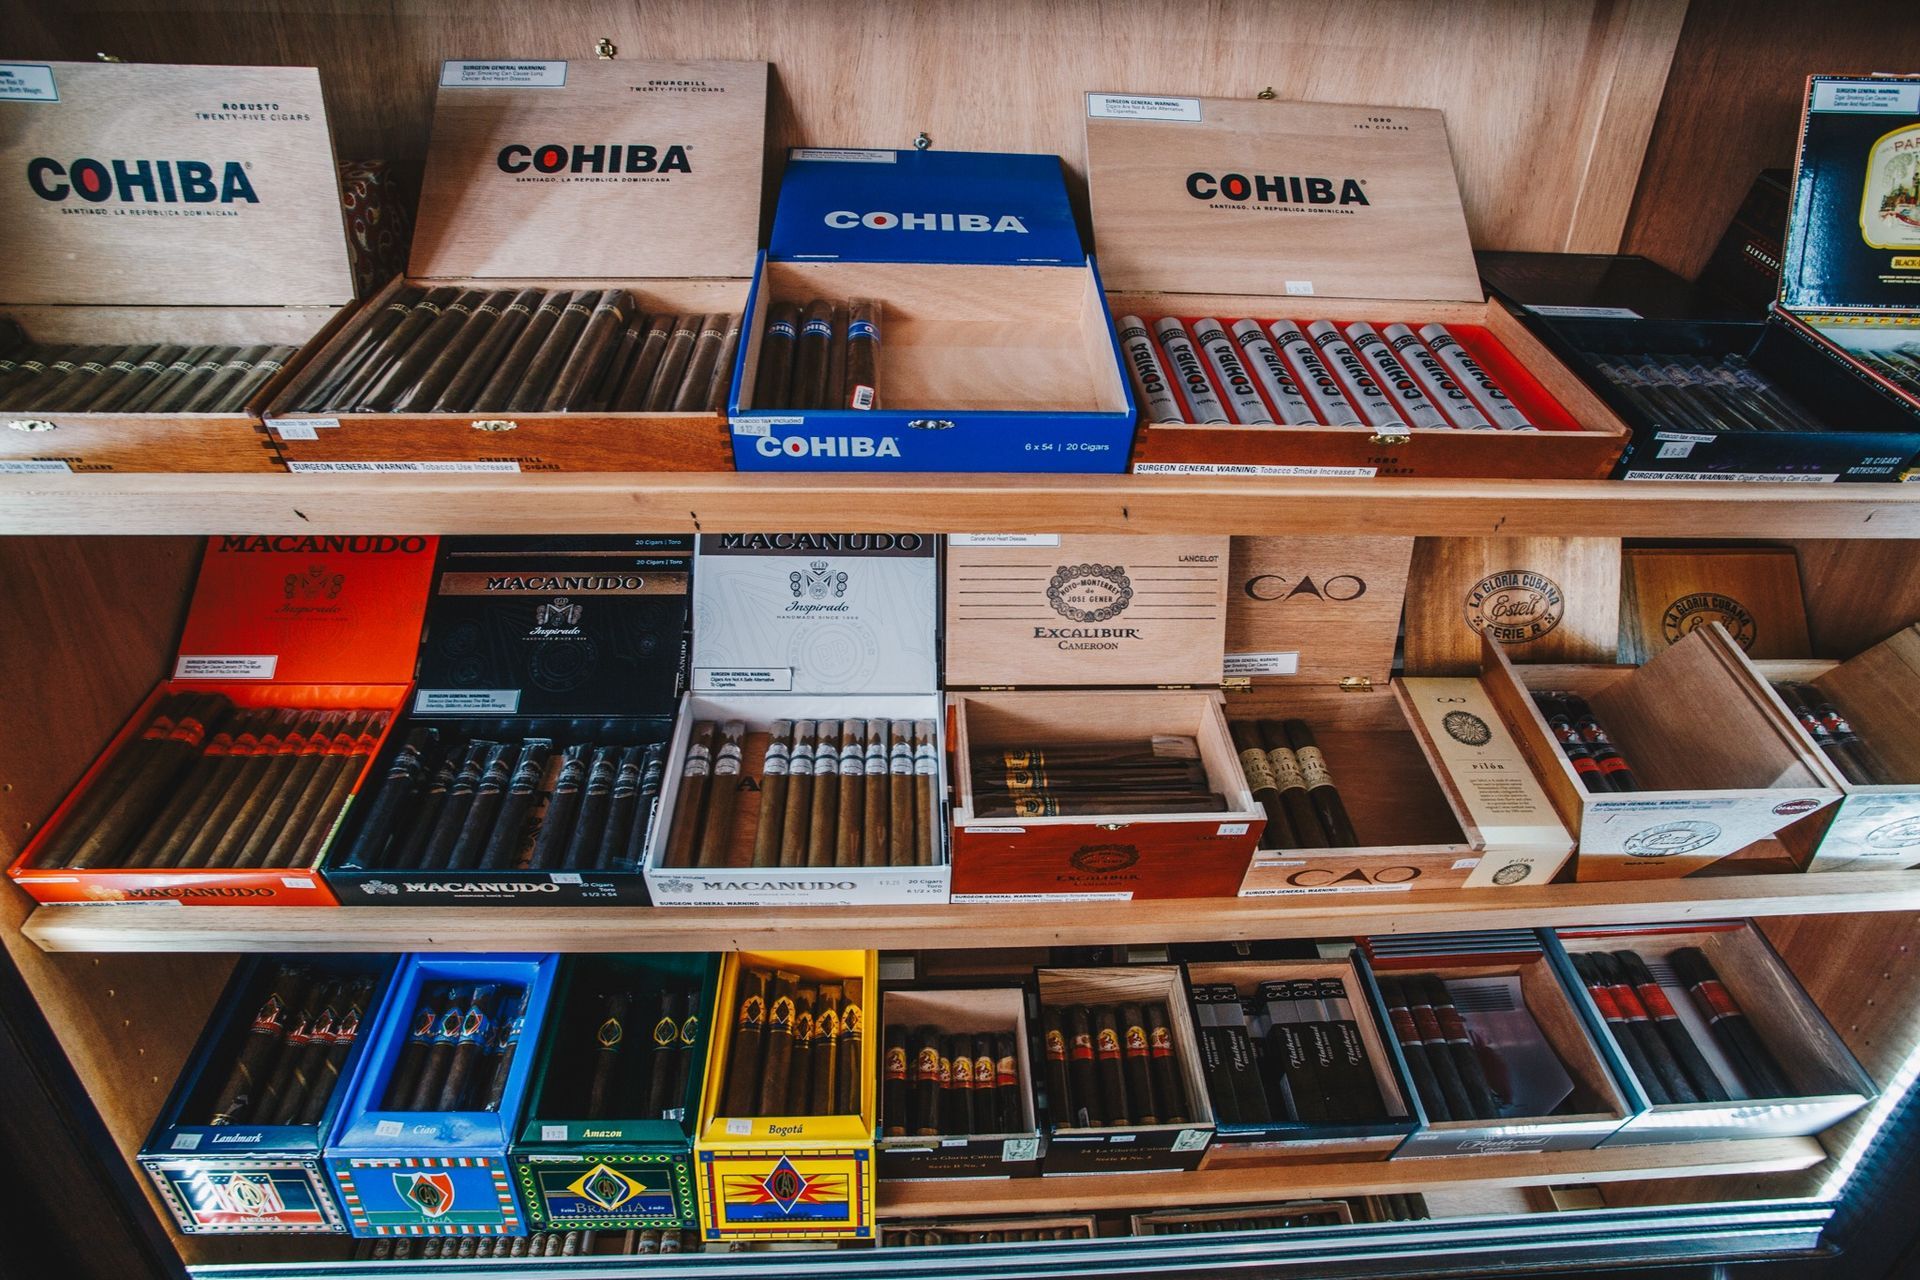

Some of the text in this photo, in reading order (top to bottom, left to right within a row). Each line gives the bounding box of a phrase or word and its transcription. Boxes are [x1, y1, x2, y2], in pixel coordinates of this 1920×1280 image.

[270, 113, 310, 121] CIGARS
[496, 144, 692, 174] COHIBA
[27, 157, 260, 204] COHIBA
[1186, 172, 1370, 206] COHIBA
[114, 208, 126, 216] LA
[824, 211, 1028, 233] COHIBA
[1131, 343, 1165, 394] COHIBA
[1173, 346, 1210, 395] COHIBA
[1215, 346, 1254, 396] COHIBA
[1260, 346, 1300, 396] COHIBA
[1296, 348, 1341, 396] COHIBA
[1335, 347, 1382, 397] COHIBA
[1373, 349, 1422, 399] COHIBA
[1416, 350, 1467, 400] COHIBA
[1149, 398, 1171, 406] TORO
[756, 436, 901, 457] COHIBA
[1080, 443, 1109, 452] Cigars
[292, 463, 333, 471] SURGEON
[336, 463, 373, 471] GENERAL
[421, 463, 455, 471] Tobacco
[457, 463, 472, 471] Use
[1137, 464, 1176, 472] SURGEON
[1861, 457, 1872, 465] 20
[1628, 472, 1664, 480] SURGEON
[1665, 472, 1697, 480] GENERAL
[1737, 474, 1756, 482] Cigar
[1847, 466, 1894, 474] ROTHSCHILD
[218, 535, 427, 553] MACANUDO
[719, 534, 923, 551] MACANUDO
[484, 576, 644, 591] MACANUDO
[1245, 574, 1366, 602] CAO
[1469, 574, 1560, 609] LA GLORIA CUBANA
[785, 600, 849, 615] Inspirado
[1666, 612, 1679, 628] LA
[1675, 597, 1709, 614] GLORIA
[1712, 598, 1750, 627] CUBANA
[529, 627, 581, 637] Inspirado
[1033, 627, 1143, 640] EXCALIBUR
[1531, 623, 1542, 634] R
[1058, 640, 1119, 650] CAMEROON
[676, 640, 687, 690] MACANUDO
[1286, 866, 1422, 887] CAO
[127, 888, 277, 897] MACANUDO
[402, 882, 560, 892] MACANUDO
[703, 882, 857, 890] MACANUDO
[1266, 990, 1290, 998] CAO
[413, 1125, 436, 1135] Ciao
[583, 1129, 622, 1138] Amazon
[768, 1124, 803, 1136] Bogotá
[212, 1133, 263, 1143] Landmark
